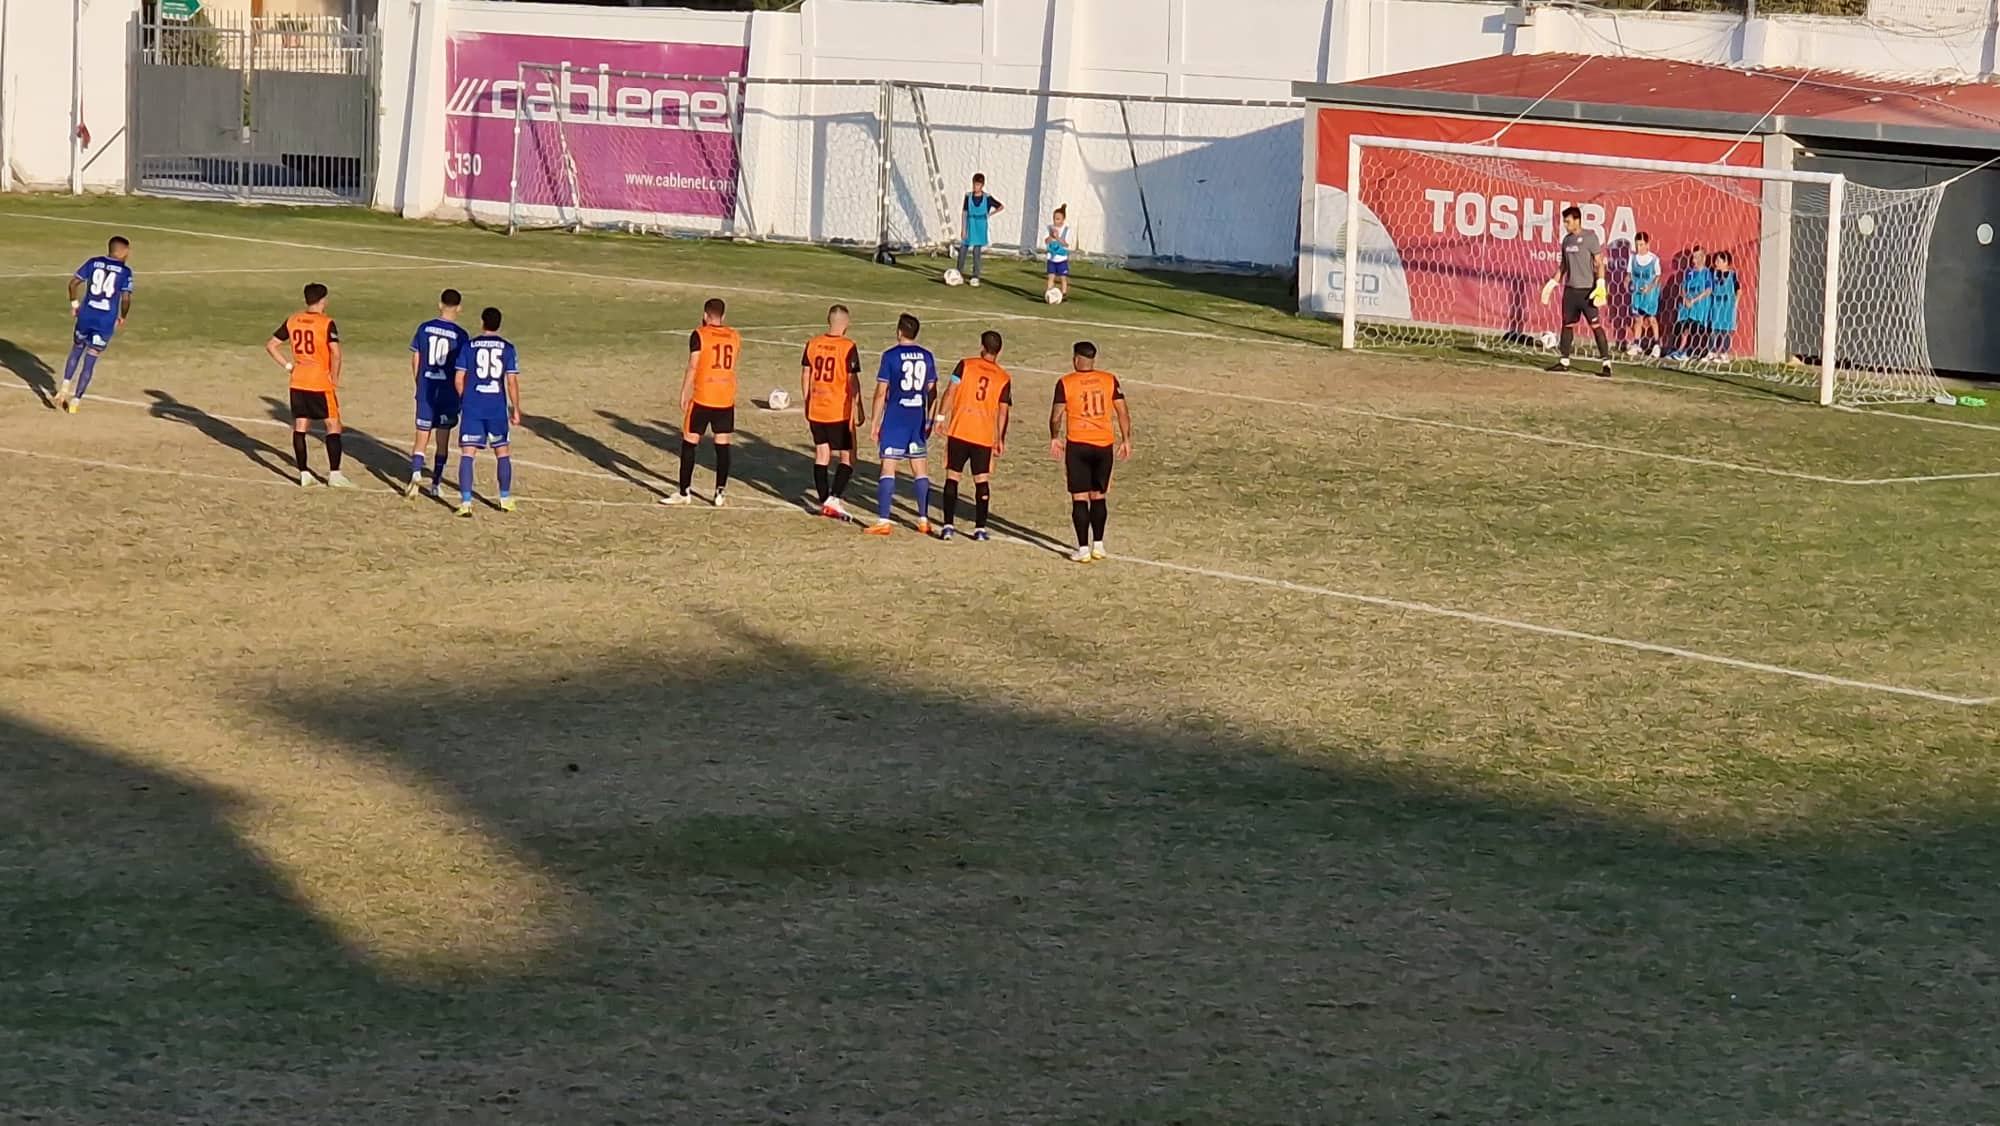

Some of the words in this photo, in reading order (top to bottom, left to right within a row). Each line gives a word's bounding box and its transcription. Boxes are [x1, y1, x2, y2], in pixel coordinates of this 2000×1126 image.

[455, 153, 482, 177] 130
[1425, 189, 1636, 253] TOSHIBA
[91, 268, 116, 298] 94
[292, 329, 315, 355] 28
[428, 335, 449, 367] 10
[476, 348, 503, 379] 95
[711, 343, 733, 370] 16
[814, 355, 836, 383] 99
[900, 360, 926, 391] 39
[975, 376, 990, 402] 3
[1080, 390, 1105, 417] 10
